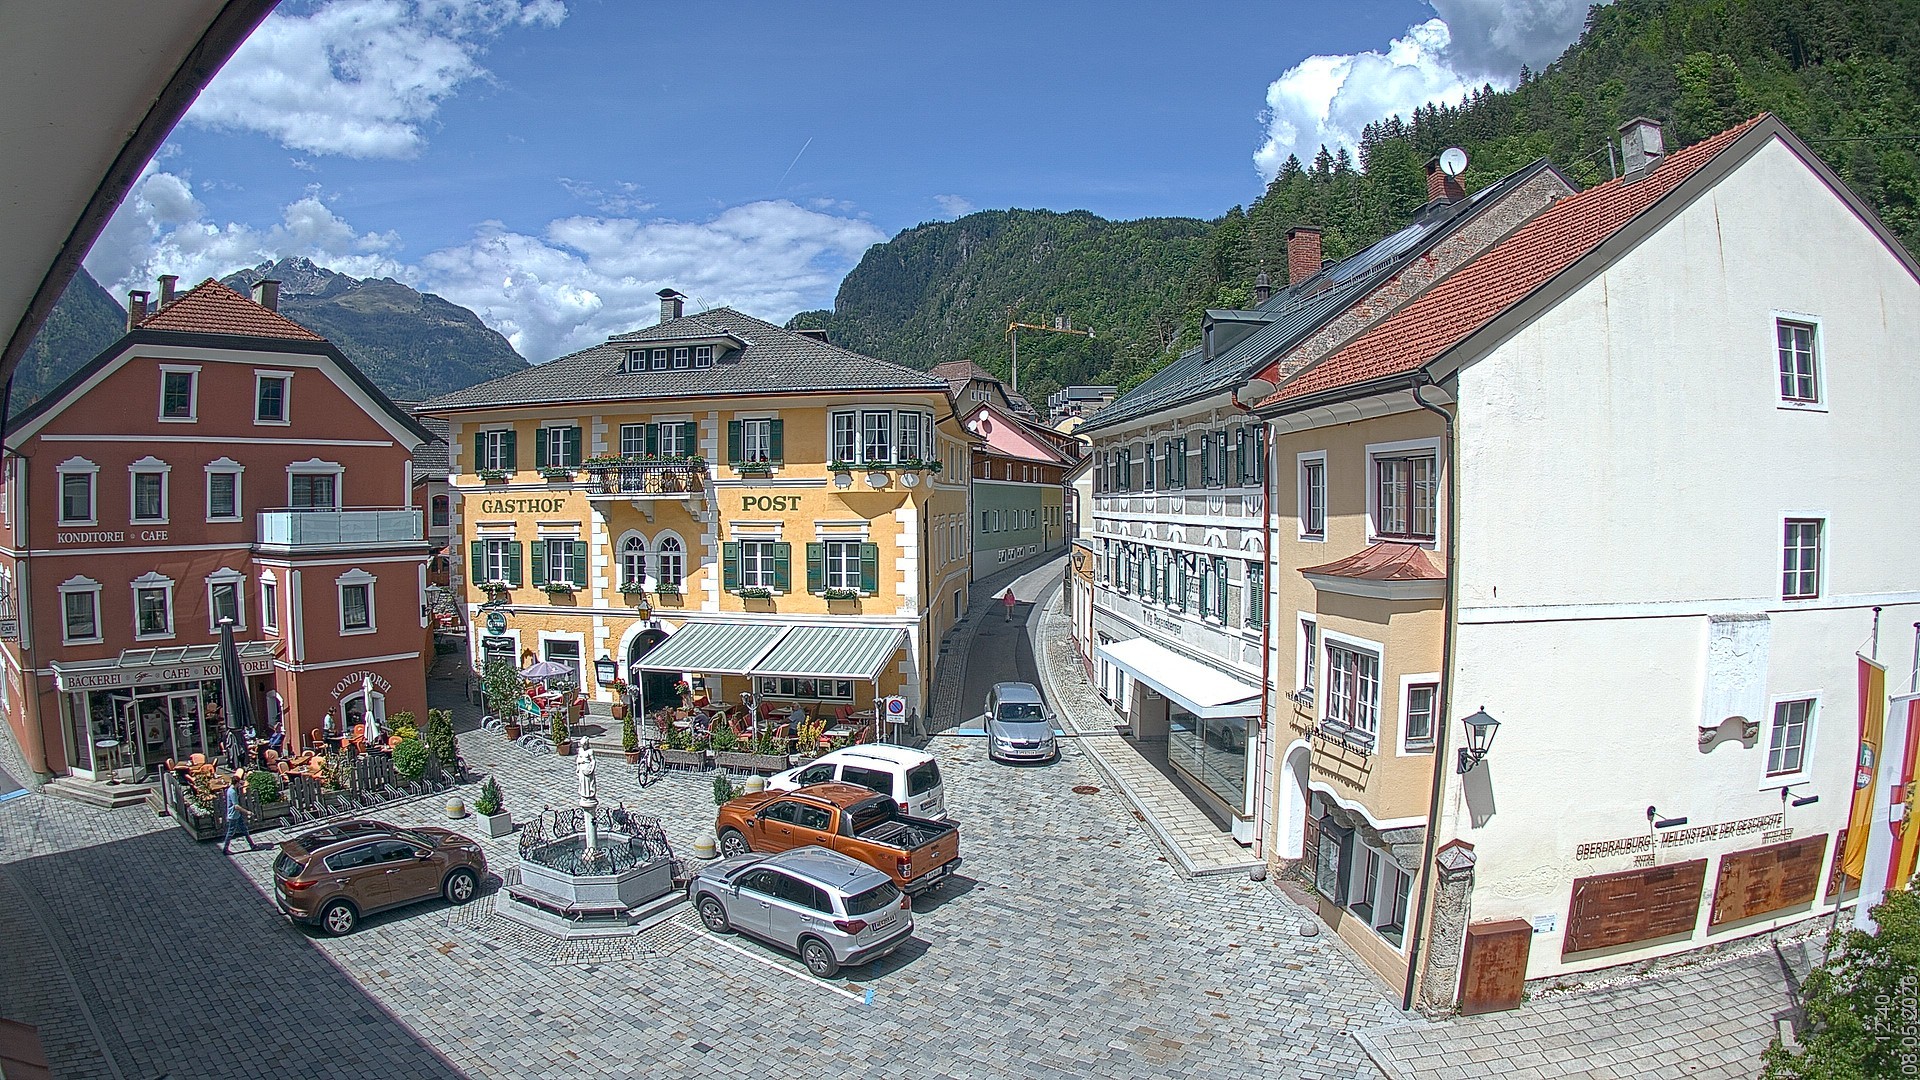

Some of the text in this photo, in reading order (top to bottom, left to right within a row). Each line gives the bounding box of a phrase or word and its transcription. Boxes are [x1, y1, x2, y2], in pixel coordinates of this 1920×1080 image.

[481, 495, 802, 514] GASTHOF POST
[57, 530, 168, 544] KONDITOREI CAFE
[68, 673, 122, 688] BÄCKEREI
[162, 667, 190, 680] CAFE
[331, 671, 392, 699] KONDITOREI
[1576, 835, 1652, 857] OBERDRAUBURG
[1659, 824, 1720, 844] MEILENSTEINE
[1719, 819, 1736, 836] DER
[1736, 812, 1784, 831] GESCHICHTE
